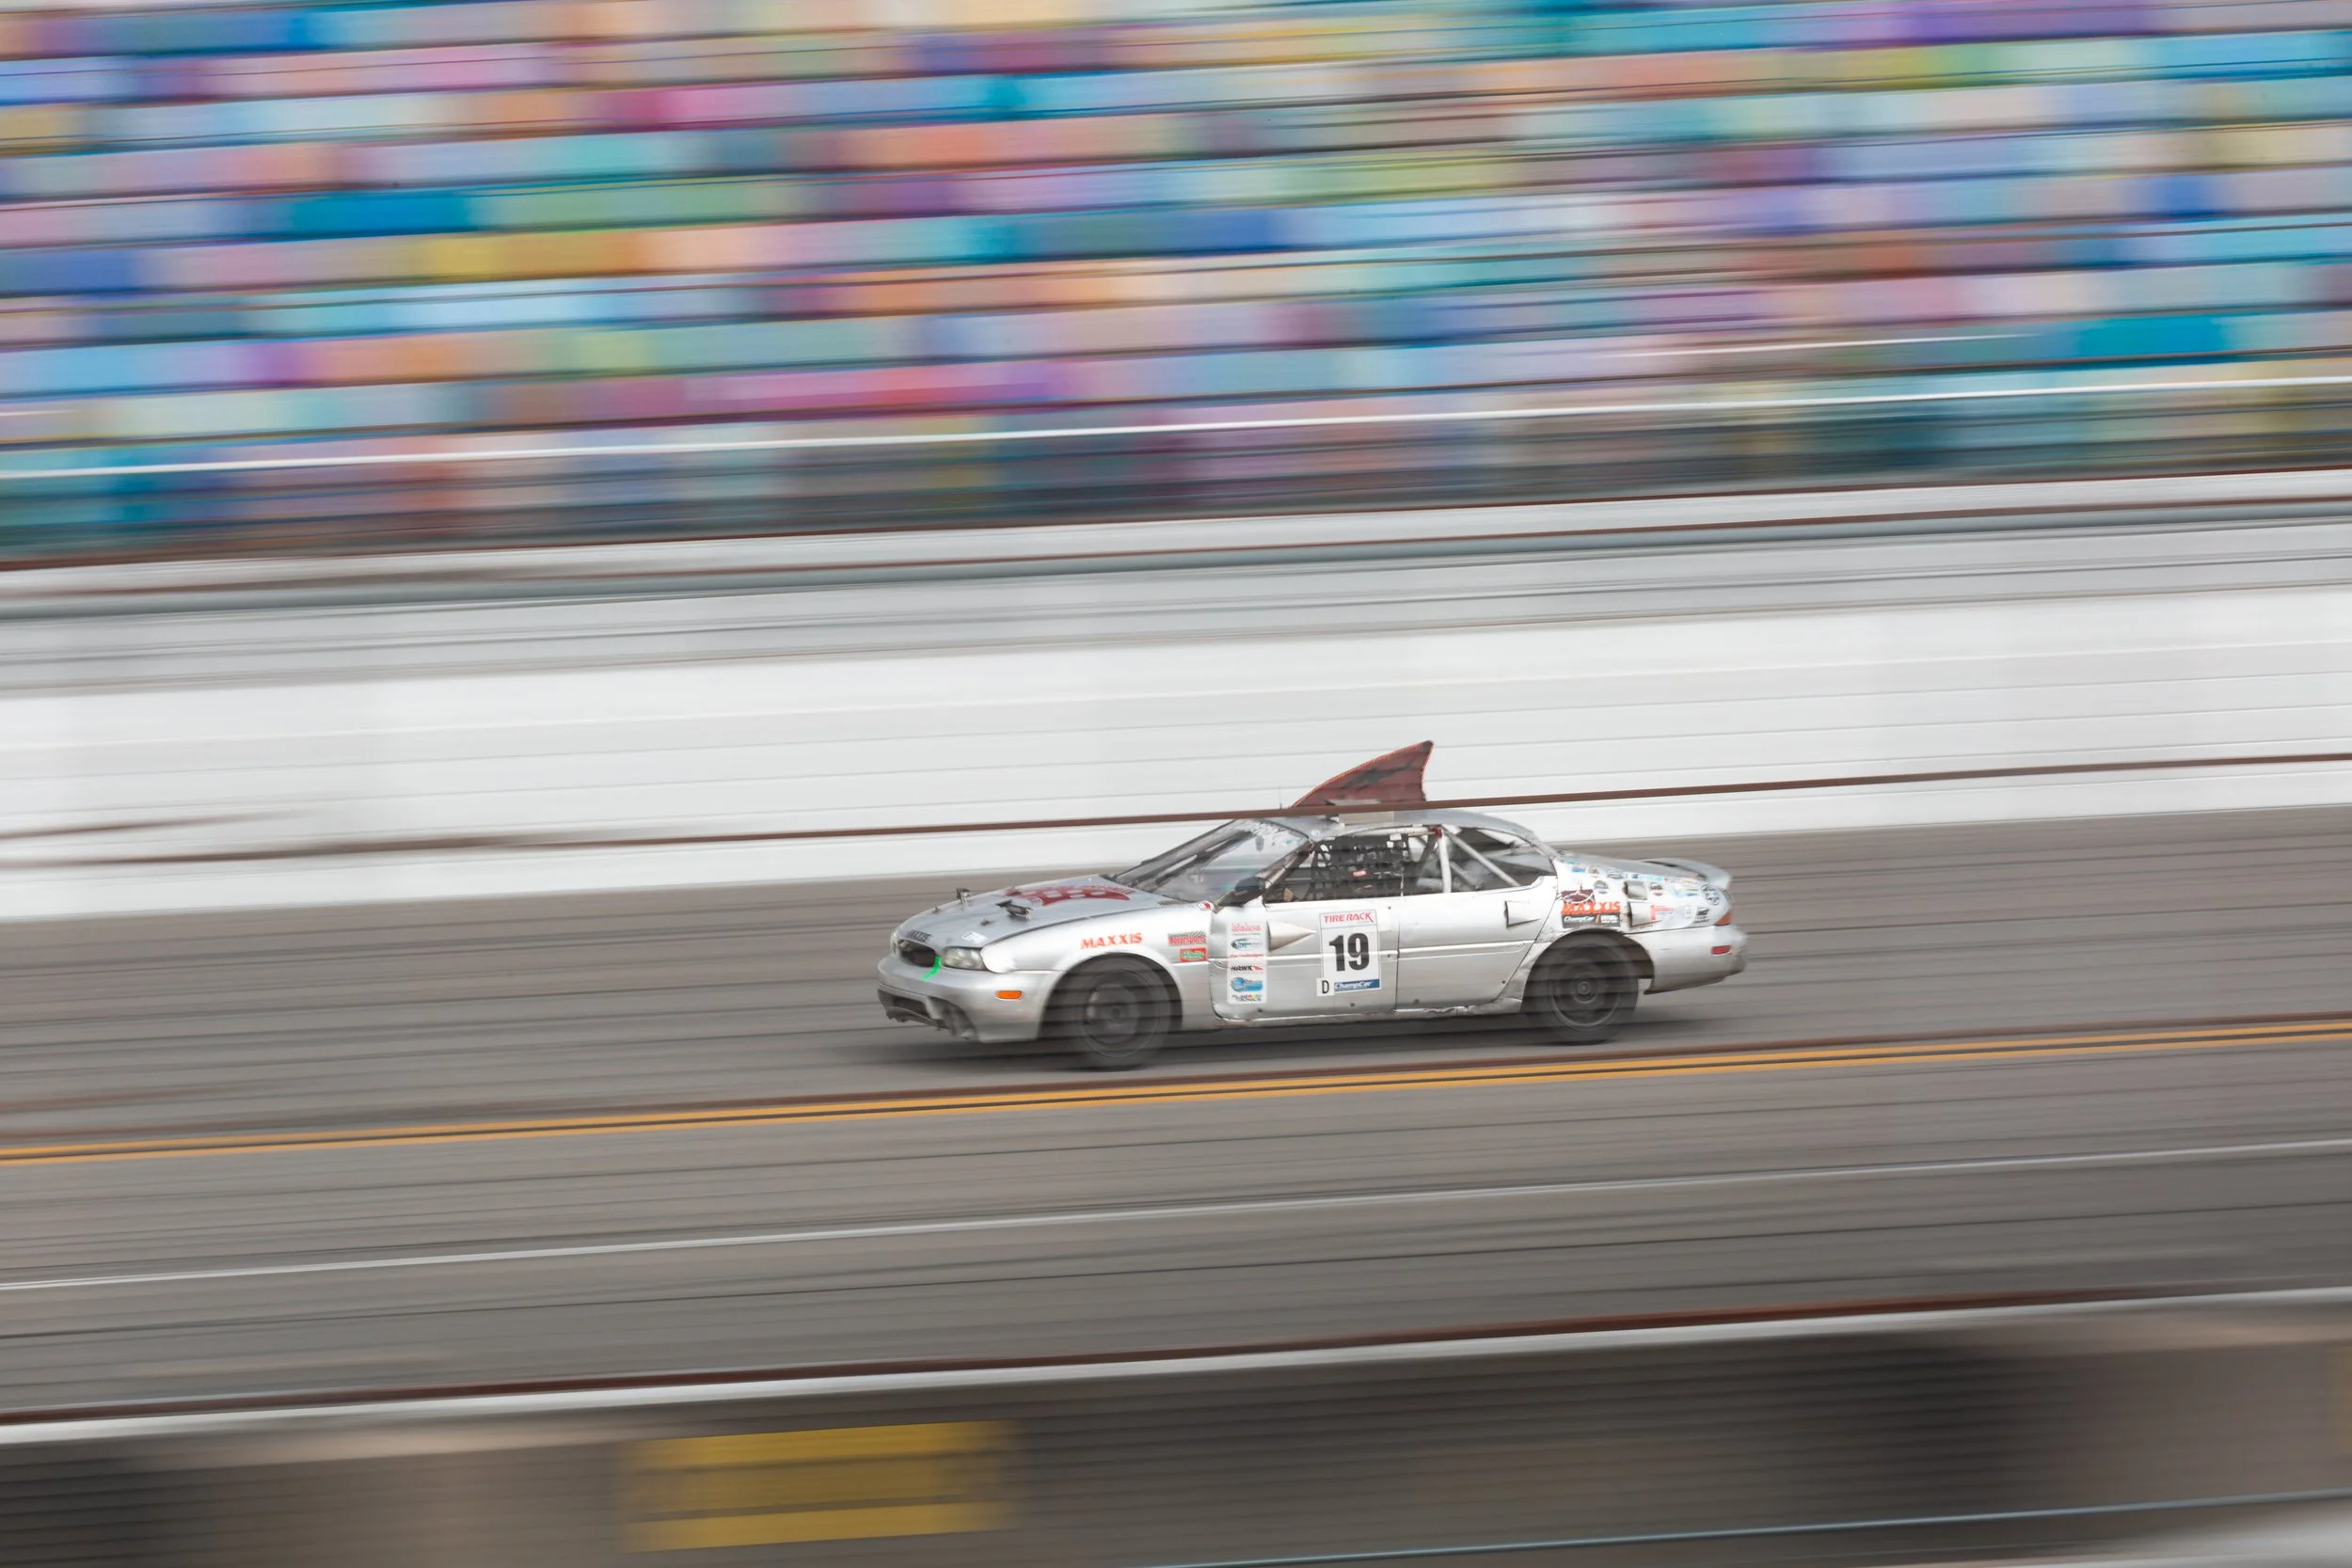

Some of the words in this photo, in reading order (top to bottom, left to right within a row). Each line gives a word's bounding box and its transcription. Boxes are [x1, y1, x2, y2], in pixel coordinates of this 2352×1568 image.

[1324, 913, 1345, 923] TIRE
[1346, 912, 1375, 923] RACK
[1081, 932, 1143, 949] MAXXIS
[1328, 932, 1370, 972] 19
[1321, 979, 1330, 994] D
[1335, 981, 1373, 990] ChampCar
